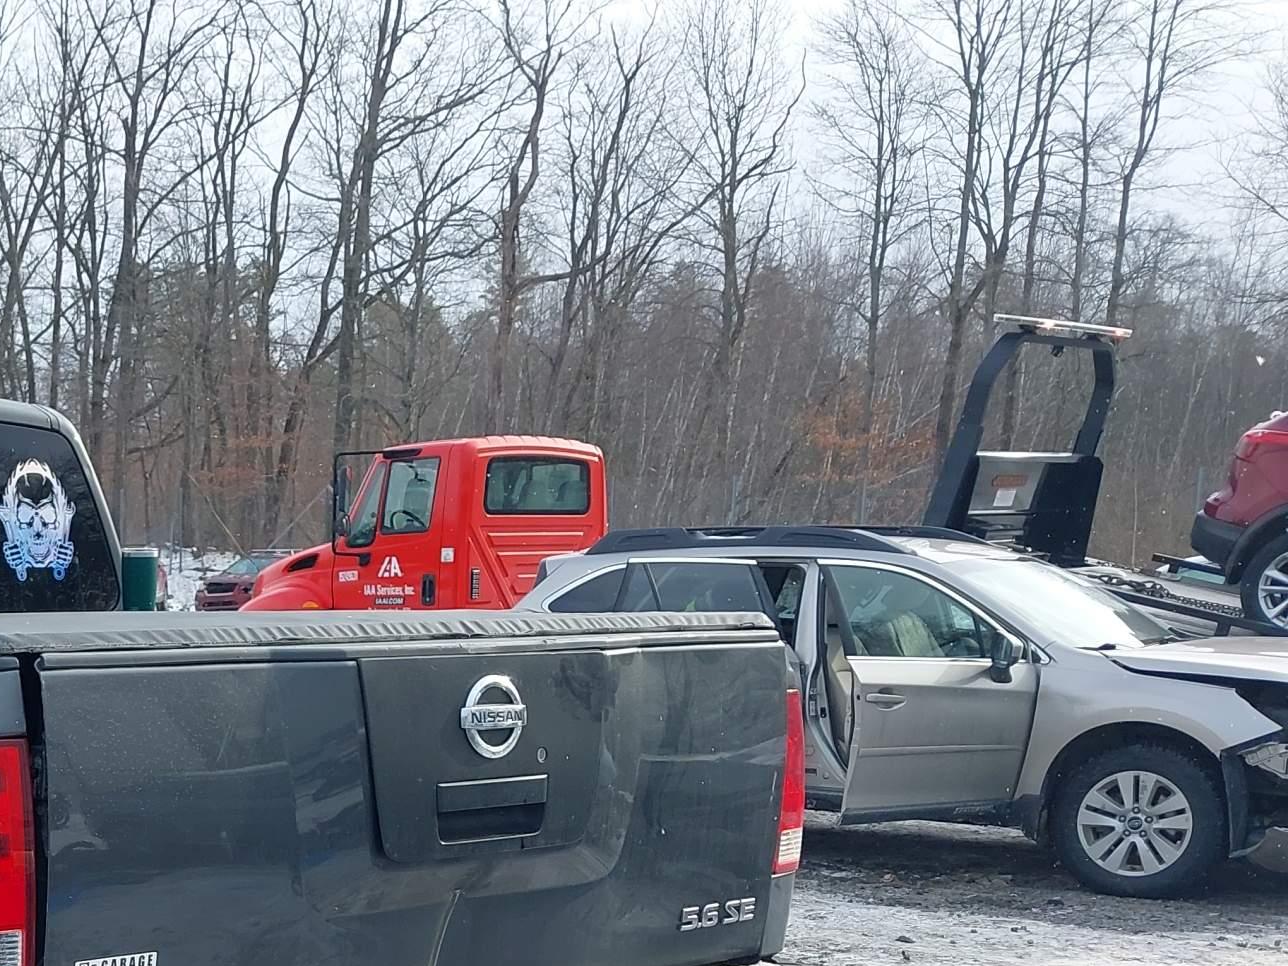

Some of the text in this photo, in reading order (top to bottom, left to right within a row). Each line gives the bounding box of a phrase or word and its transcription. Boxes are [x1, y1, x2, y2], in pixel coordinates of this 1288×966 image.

[364, 585, 375, 595] IAA
[472, 710, 522, 724] NISSAN
[679, 897, 756, 932] 5.6 SE
